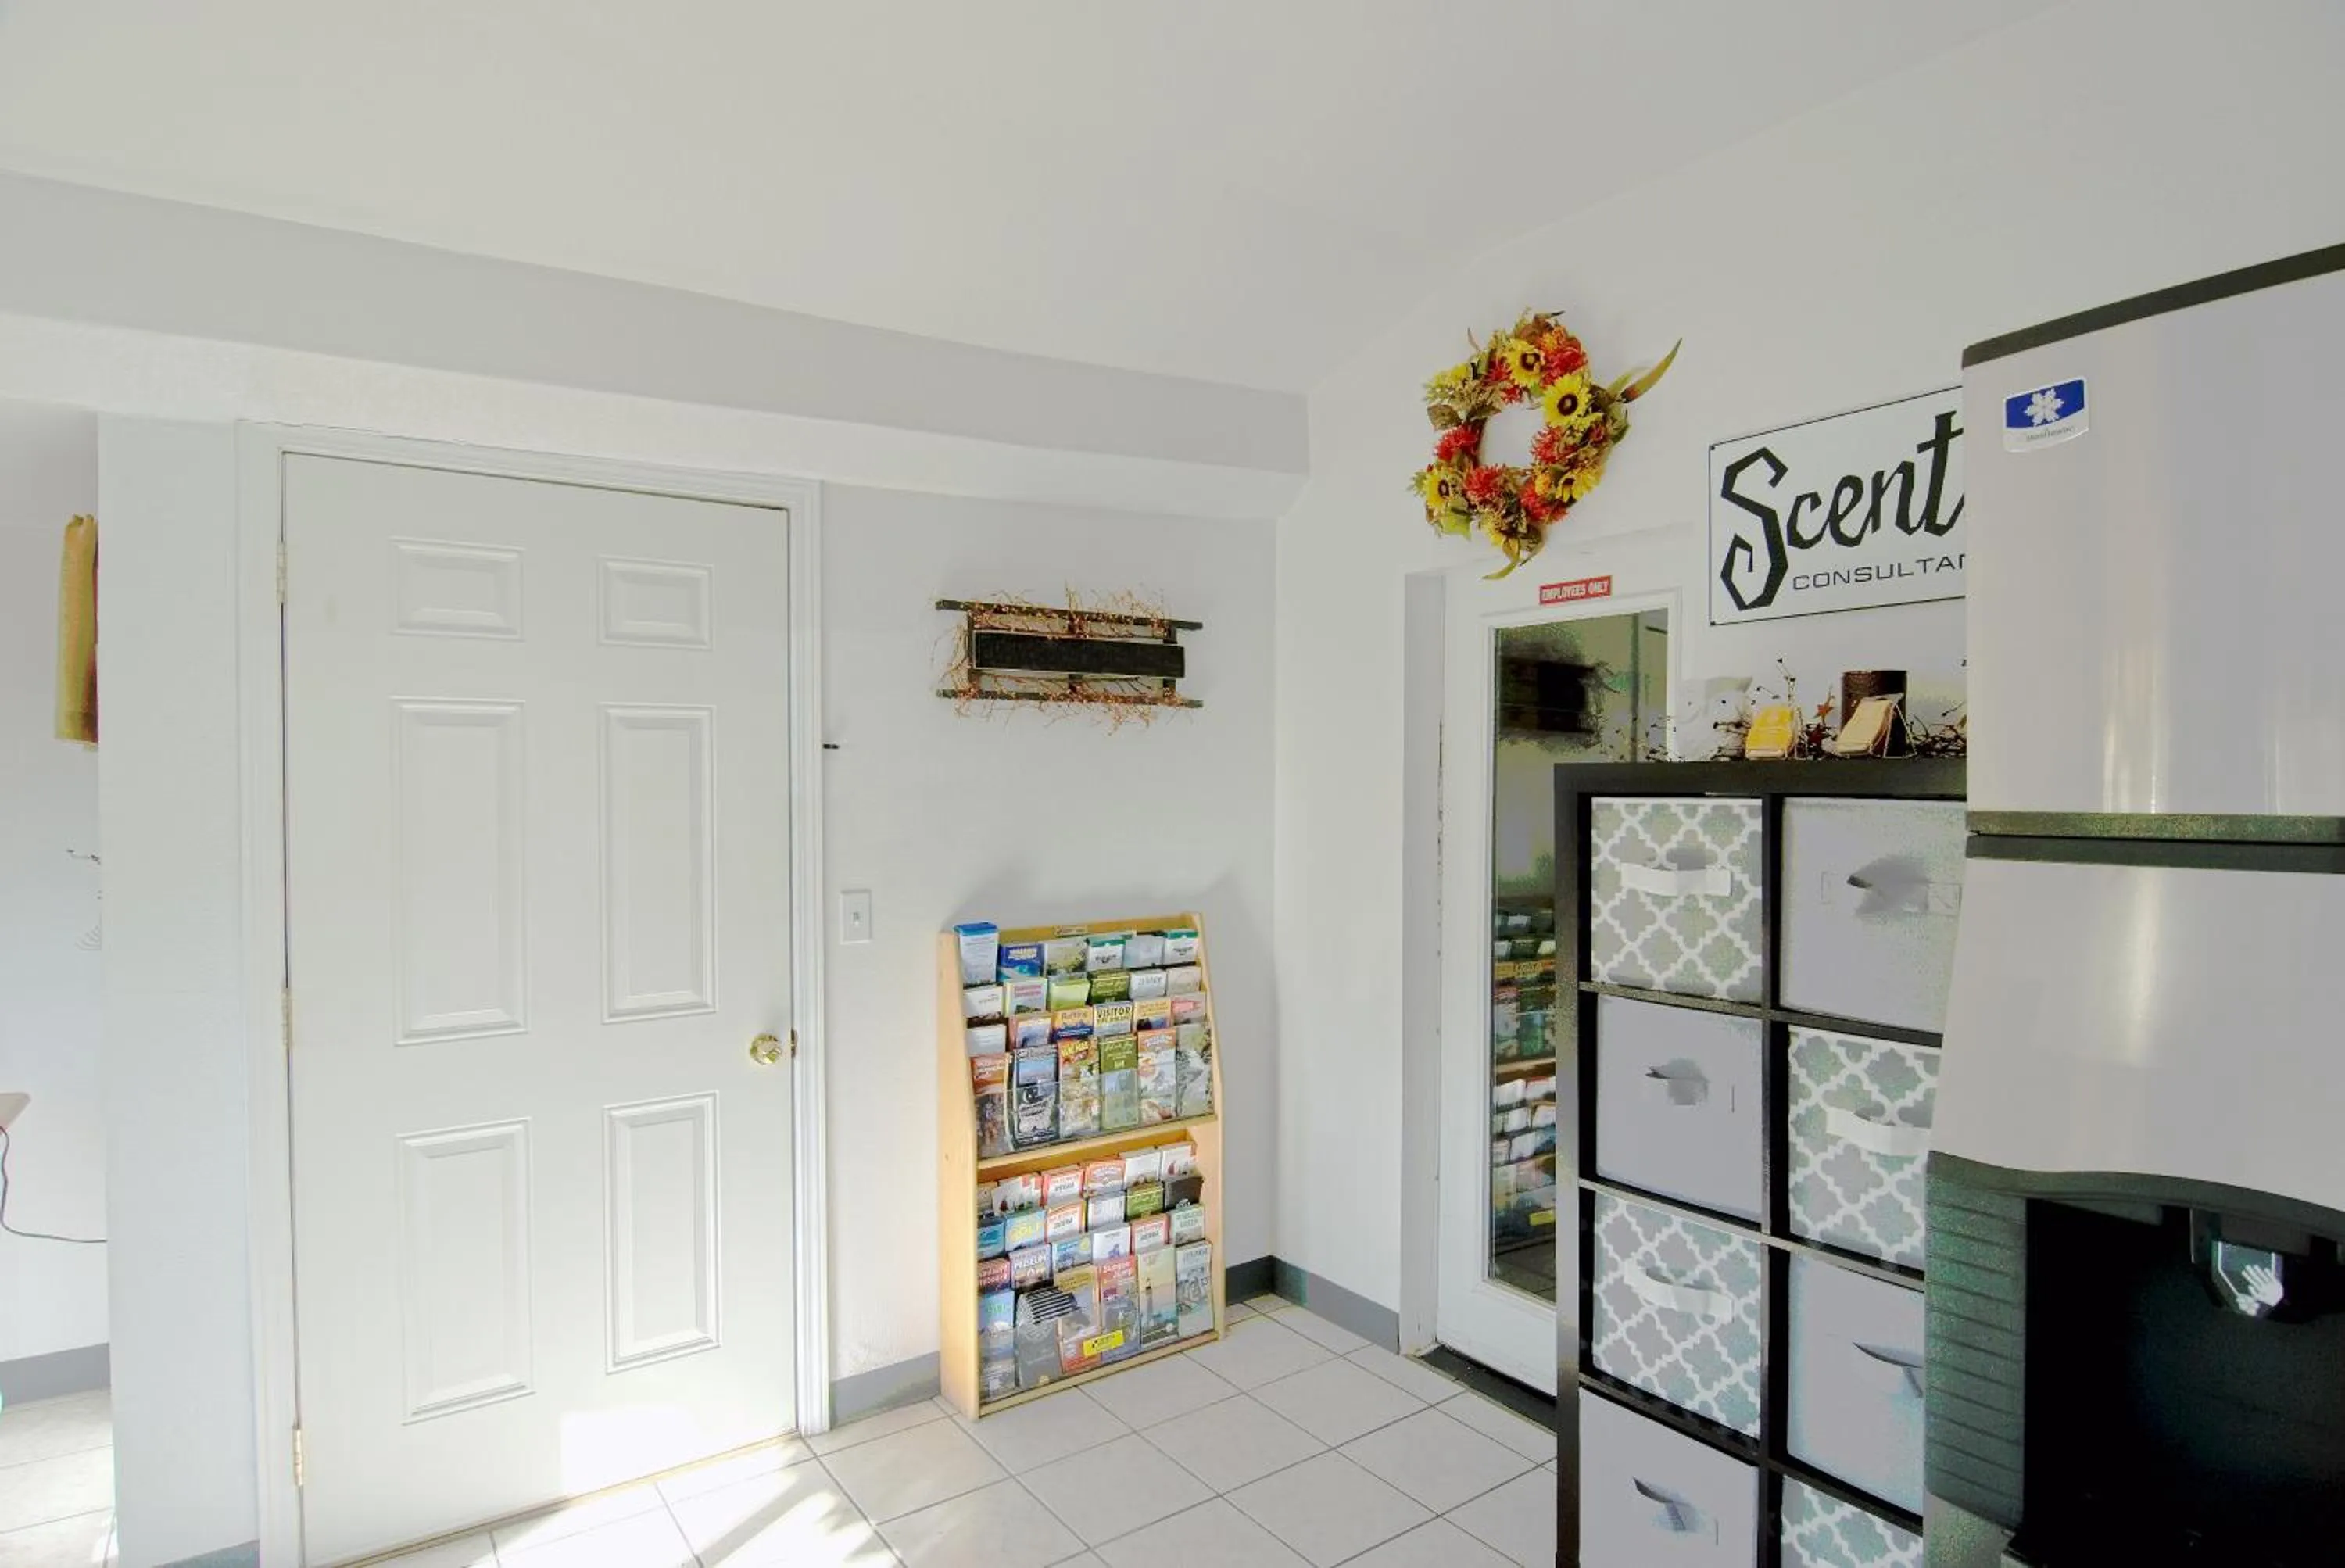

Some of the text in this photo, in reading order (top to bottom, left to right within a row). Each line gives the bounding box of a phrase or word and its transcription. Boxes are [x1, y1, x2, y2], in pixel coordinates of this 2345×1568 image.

[1541, 581, 1609, 601] EMPLOYEES ONLY
[1097, 1006, 1131, 1018] VISITOR
